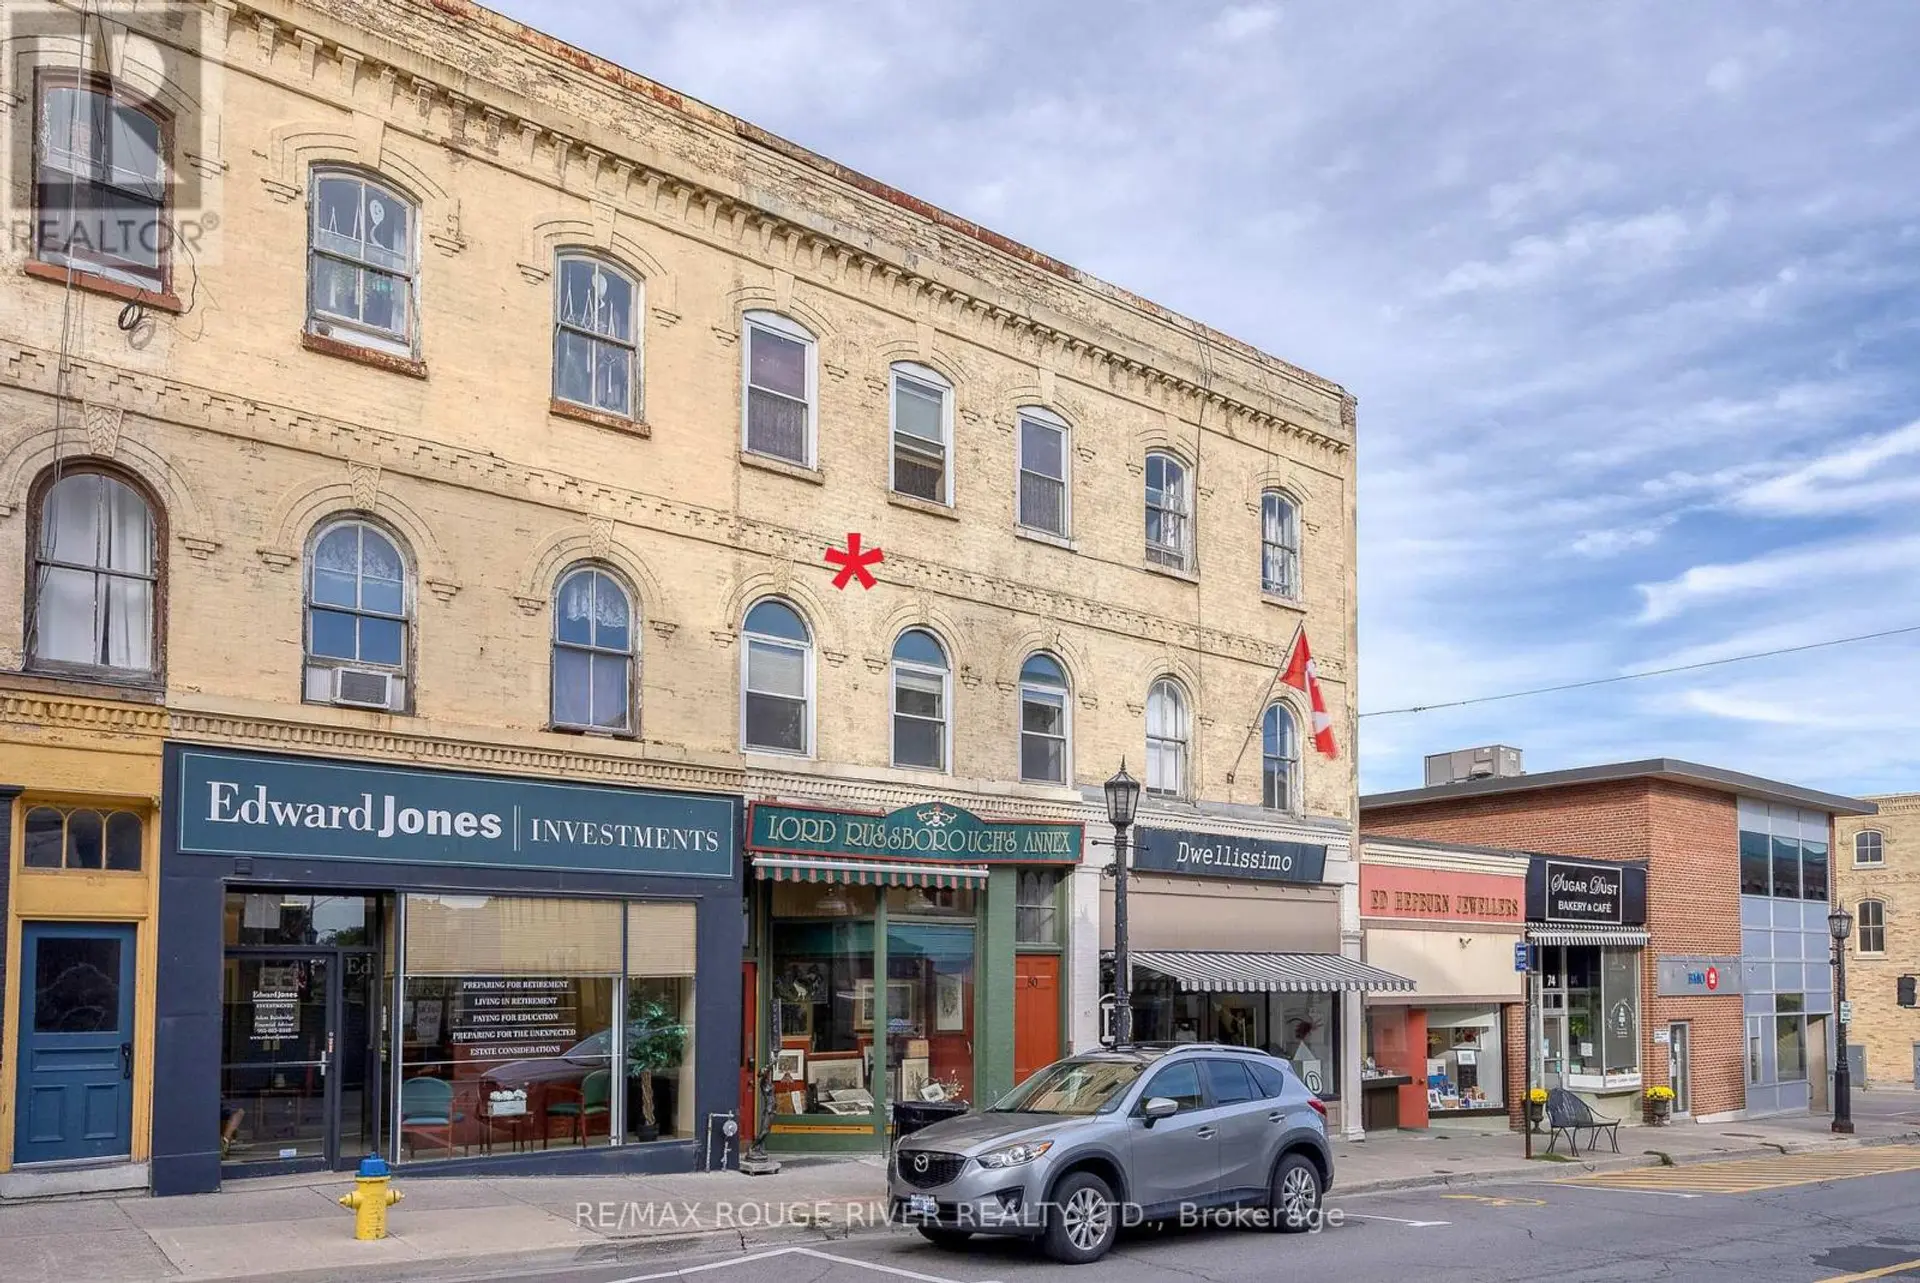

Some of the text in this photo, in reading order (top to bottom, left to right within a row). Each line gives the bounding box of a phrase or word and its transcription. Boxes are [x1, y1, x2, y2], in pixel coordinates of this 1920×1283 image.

[530, 818, 719, 853] INVESTMENTS
[768, 815, 1071, 853] LORD RUSSBOROUGH'S ANNEX
[1176, 842, 1293, 872] Dwellissimo
[1371, 889, 1518, 917] ED HEPBURN JEWELLERS
[1558, 900, 1587, 912] BAKERY
[463, 981, 505, 989] PREPARING
[523, 980, 569, 988] RETIREMENT
[474, 997, 558, 1006] LIVING IN RETIREMENT
[473, 1013, 559, 1022] PAYING FOR EDUCATION
[453, 1028, 576, 1040] PREPARING FOR THE UNEXPECTED
[470, 1046, 561, 1056] ESTATE CONSIDERATIONS
